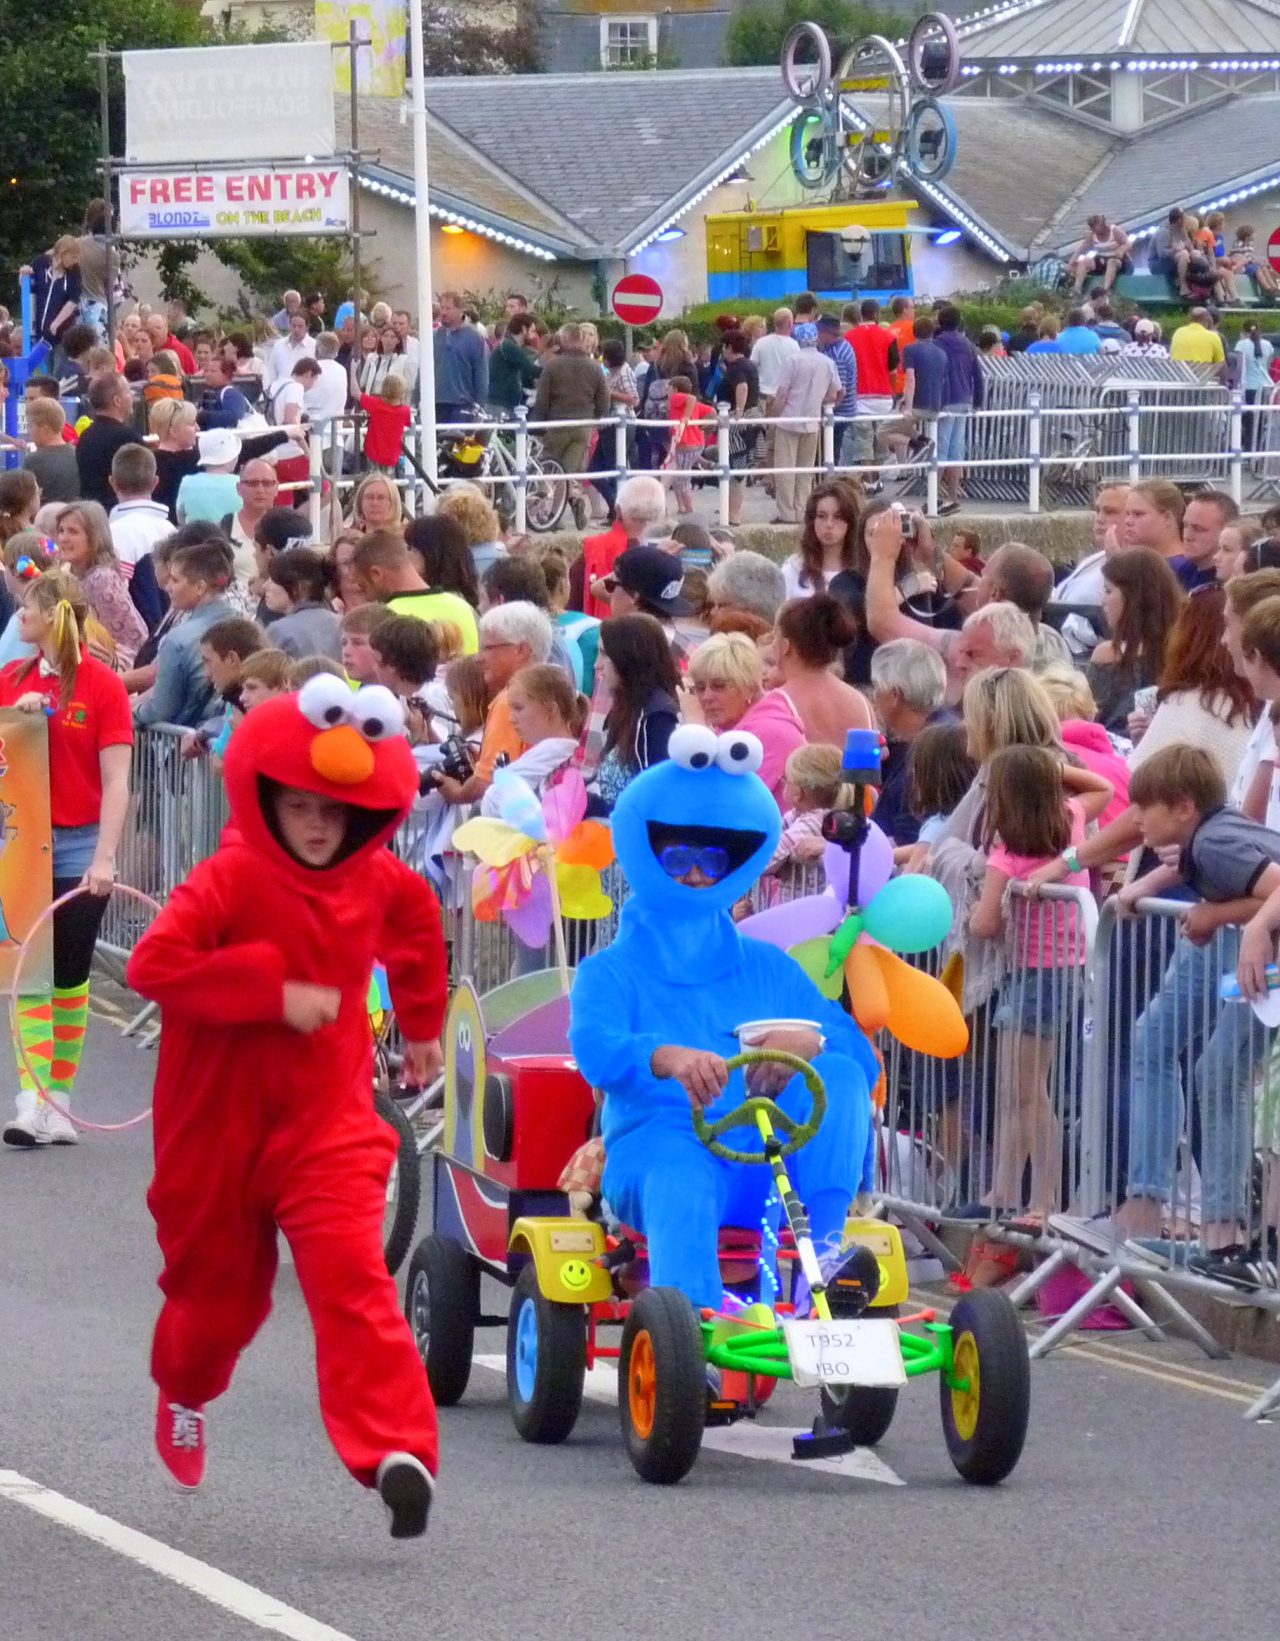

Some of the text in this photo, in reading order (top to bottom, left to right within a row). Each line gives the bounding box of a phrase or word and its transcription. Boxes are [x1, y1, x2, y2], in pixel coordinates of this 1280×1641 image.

[130, 171, 339, 205] FREE ENTRY
[216, 211, 239, 226] ON
[243, 210, 270, 225] THE
[273, 208, 322, 224] BEACH
[806, 1334, 855, 1348] T952
